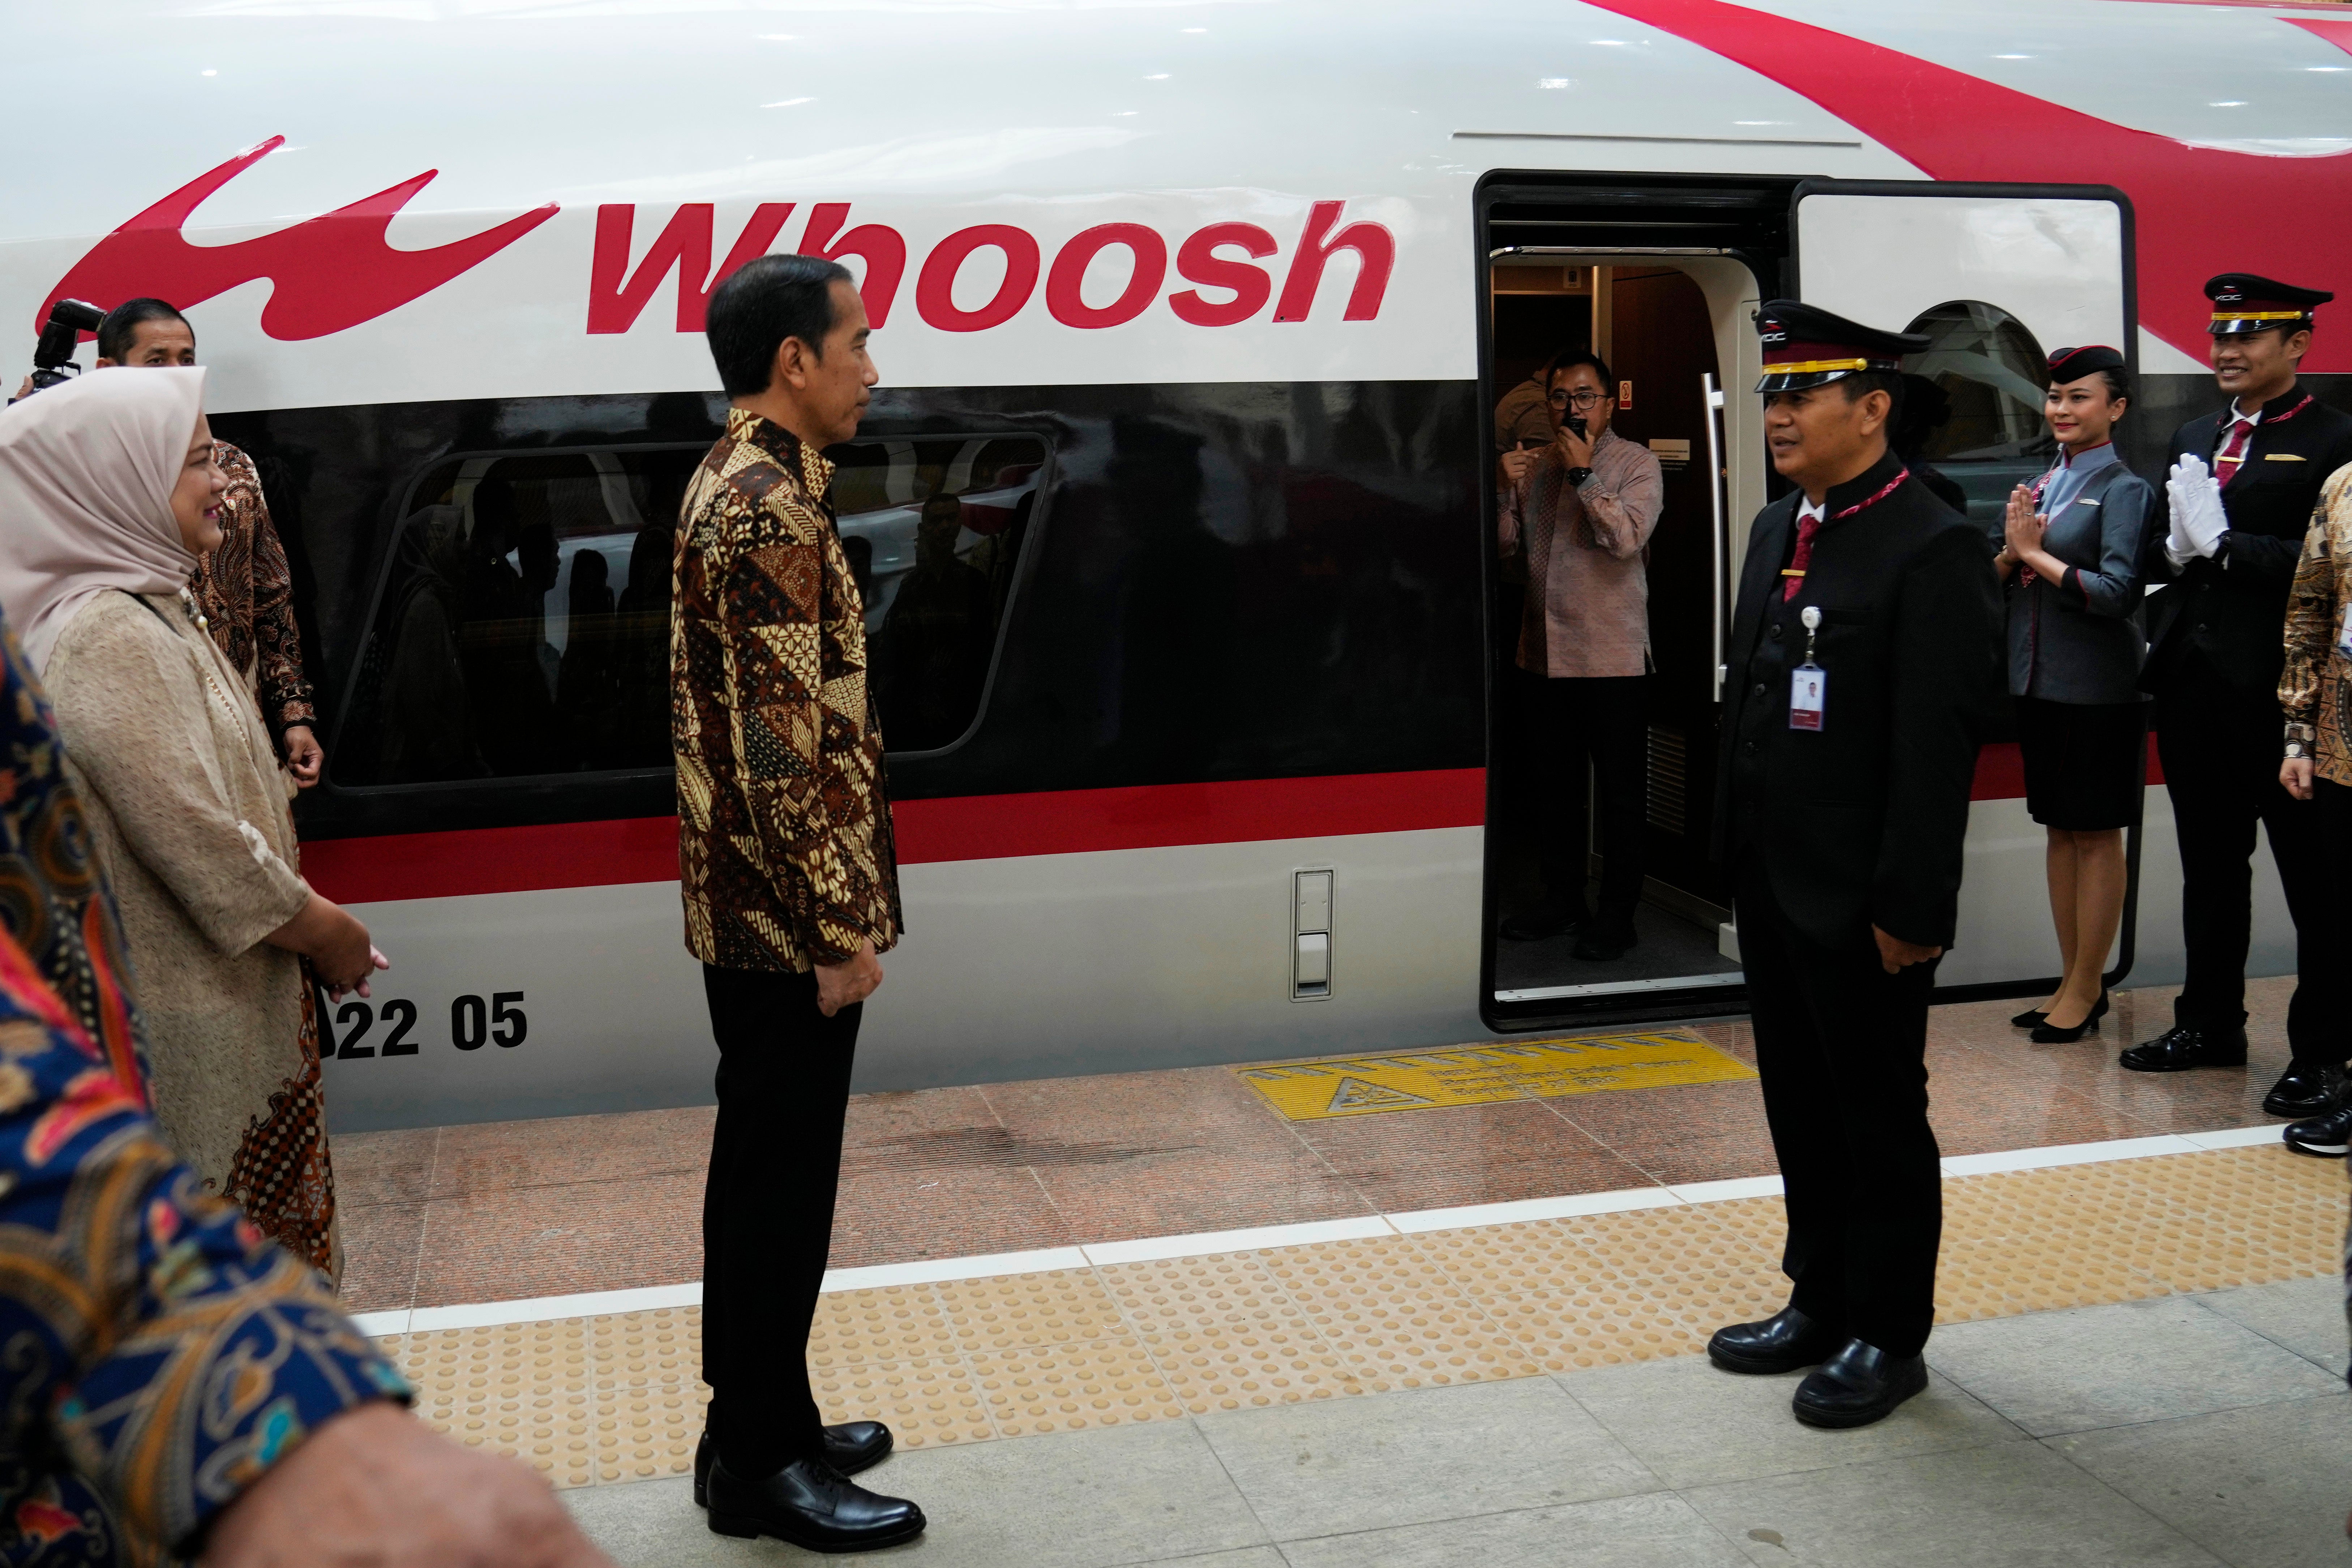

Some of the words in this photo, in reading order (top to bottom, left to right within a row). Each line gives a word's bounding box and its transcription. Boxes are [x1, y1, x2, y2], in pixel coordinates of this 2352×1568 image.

[587, 201, 1395, 334] Whoosh
[336, 999, 419, 1060] 22
[451, 991, 527, 1050] 05
